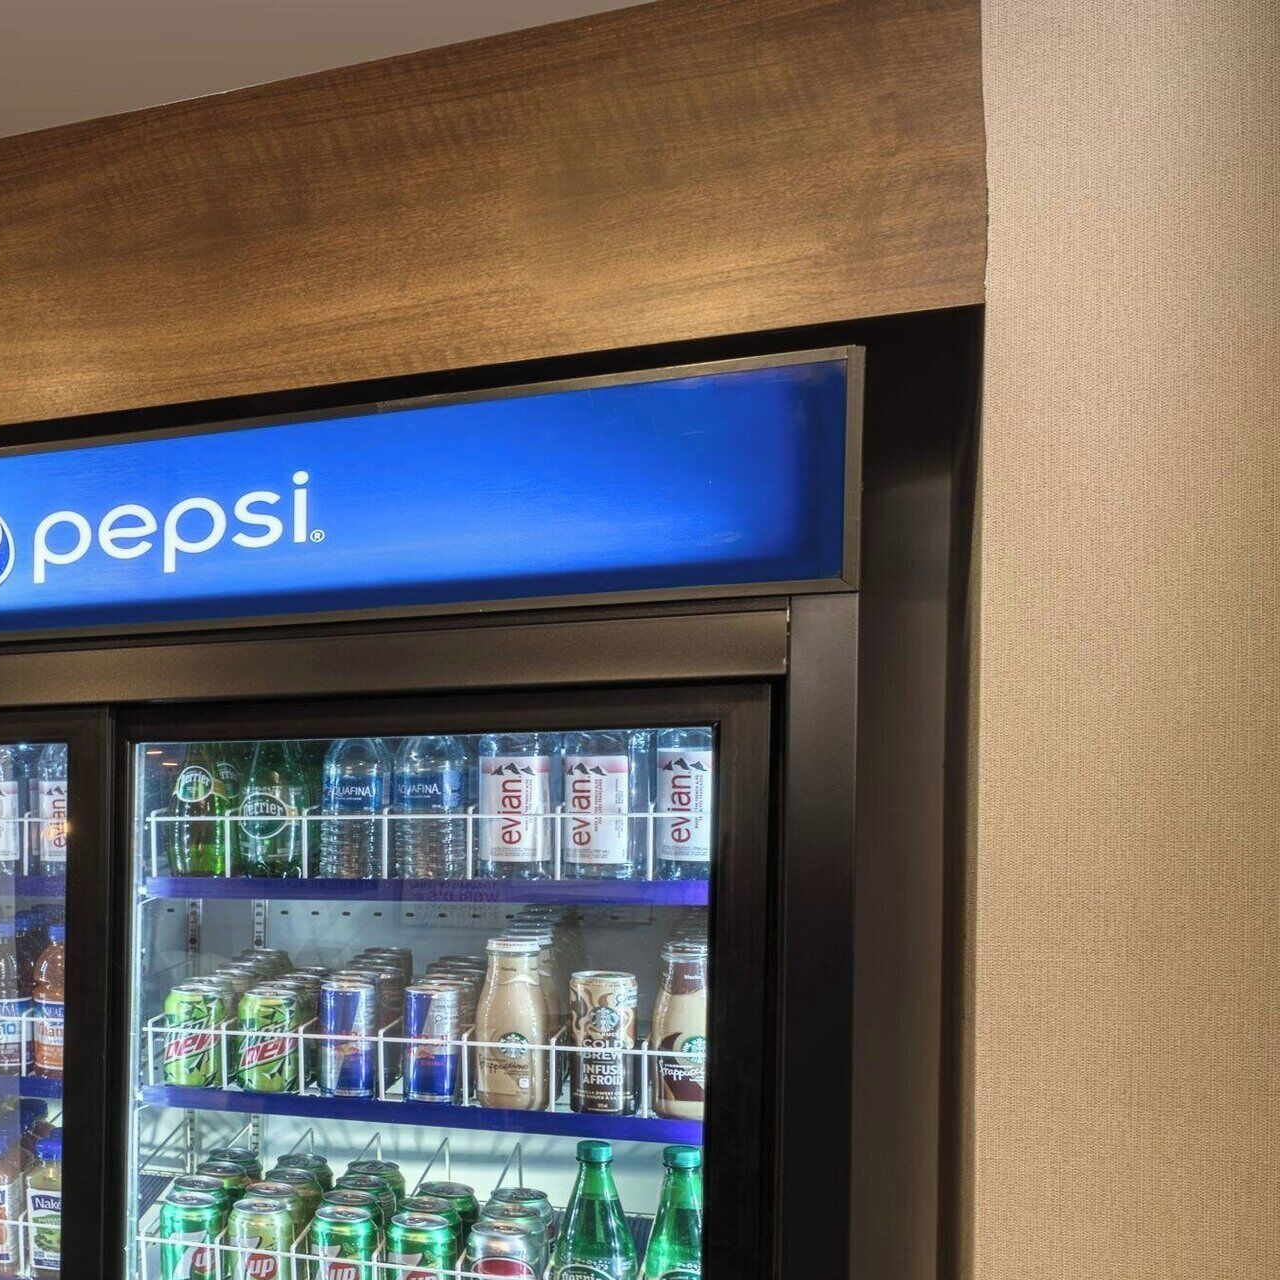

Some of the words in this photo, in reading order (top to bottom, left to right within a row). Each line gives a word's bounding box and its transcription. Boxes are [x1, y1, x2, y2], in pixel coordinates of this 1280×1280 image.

[33, 470, 309, 584] pepsi
[498, 776, 522, 844] evian
[572, 777, 591, 846] evian
[668, 774, 691, 843] evian
